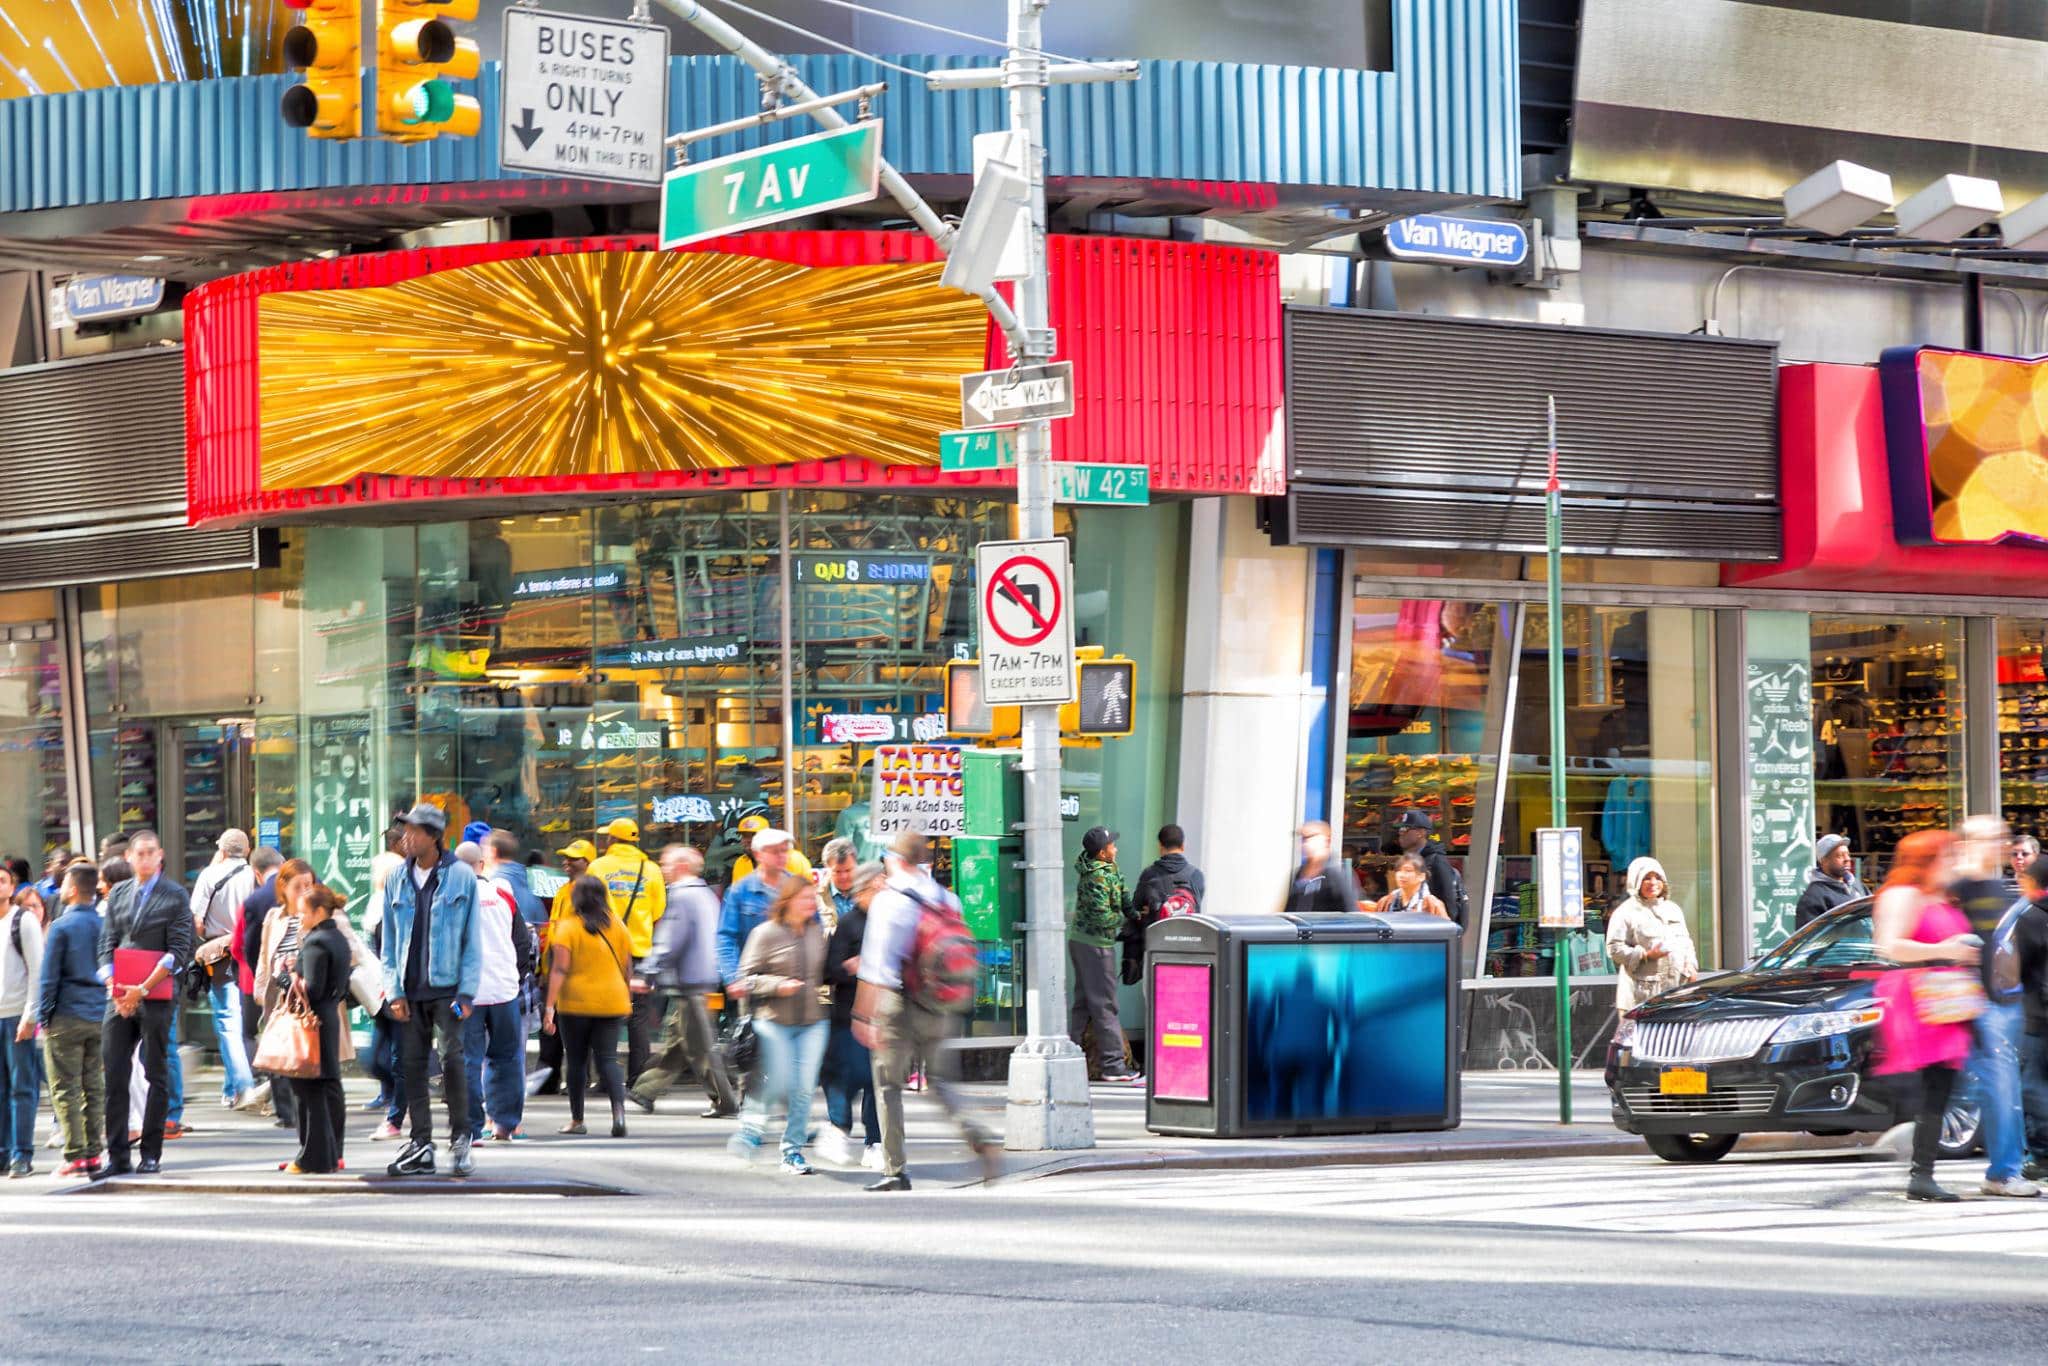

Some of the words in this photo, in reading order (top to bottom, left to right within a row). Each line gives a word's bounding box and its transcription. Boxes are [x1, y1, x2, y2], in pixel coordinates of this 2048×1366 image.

[538, 26, 635, 66] BUSES
[539, 62, 548, 75] &
[552, 63, 587, 80] RIGHT
[592, 68, 633, 84] TURNS
[547, 82, 624, 118] ONLY
[566, 121, 646, 146] 4PM-7PM
[555, 143, 590, 164] MON
[594, 150, 624, 166] THRU
[629, 152, 654, 171] FRI
[723, 171, 746, 215] 7
[1400, 217, 1439, 247] Van
[1440, 221, 1517, 258] Wagner
[66, 283, 101, 308] Van
[101, 276, 157, 307] Wagner
[979, 387, 1010, 410] ONE
[1023, 380, 1058, 401] WAY
[953, 436, 970, 467] 7
[975, 434, 992, 451] AV
[1075, 468, 1092, 494] W
[1100, 470, 1127, 499] 42
[1130, 470, 1146, 487] ST
[989, 652, 1064, 673] 7AM-7PM
[991, 677, 1027, 690] EXCEPT
[1031, 675, 1064, 688] BUSES
[881, 800, 899, 813] 303
[915, 800, 940, 813] 42nd
